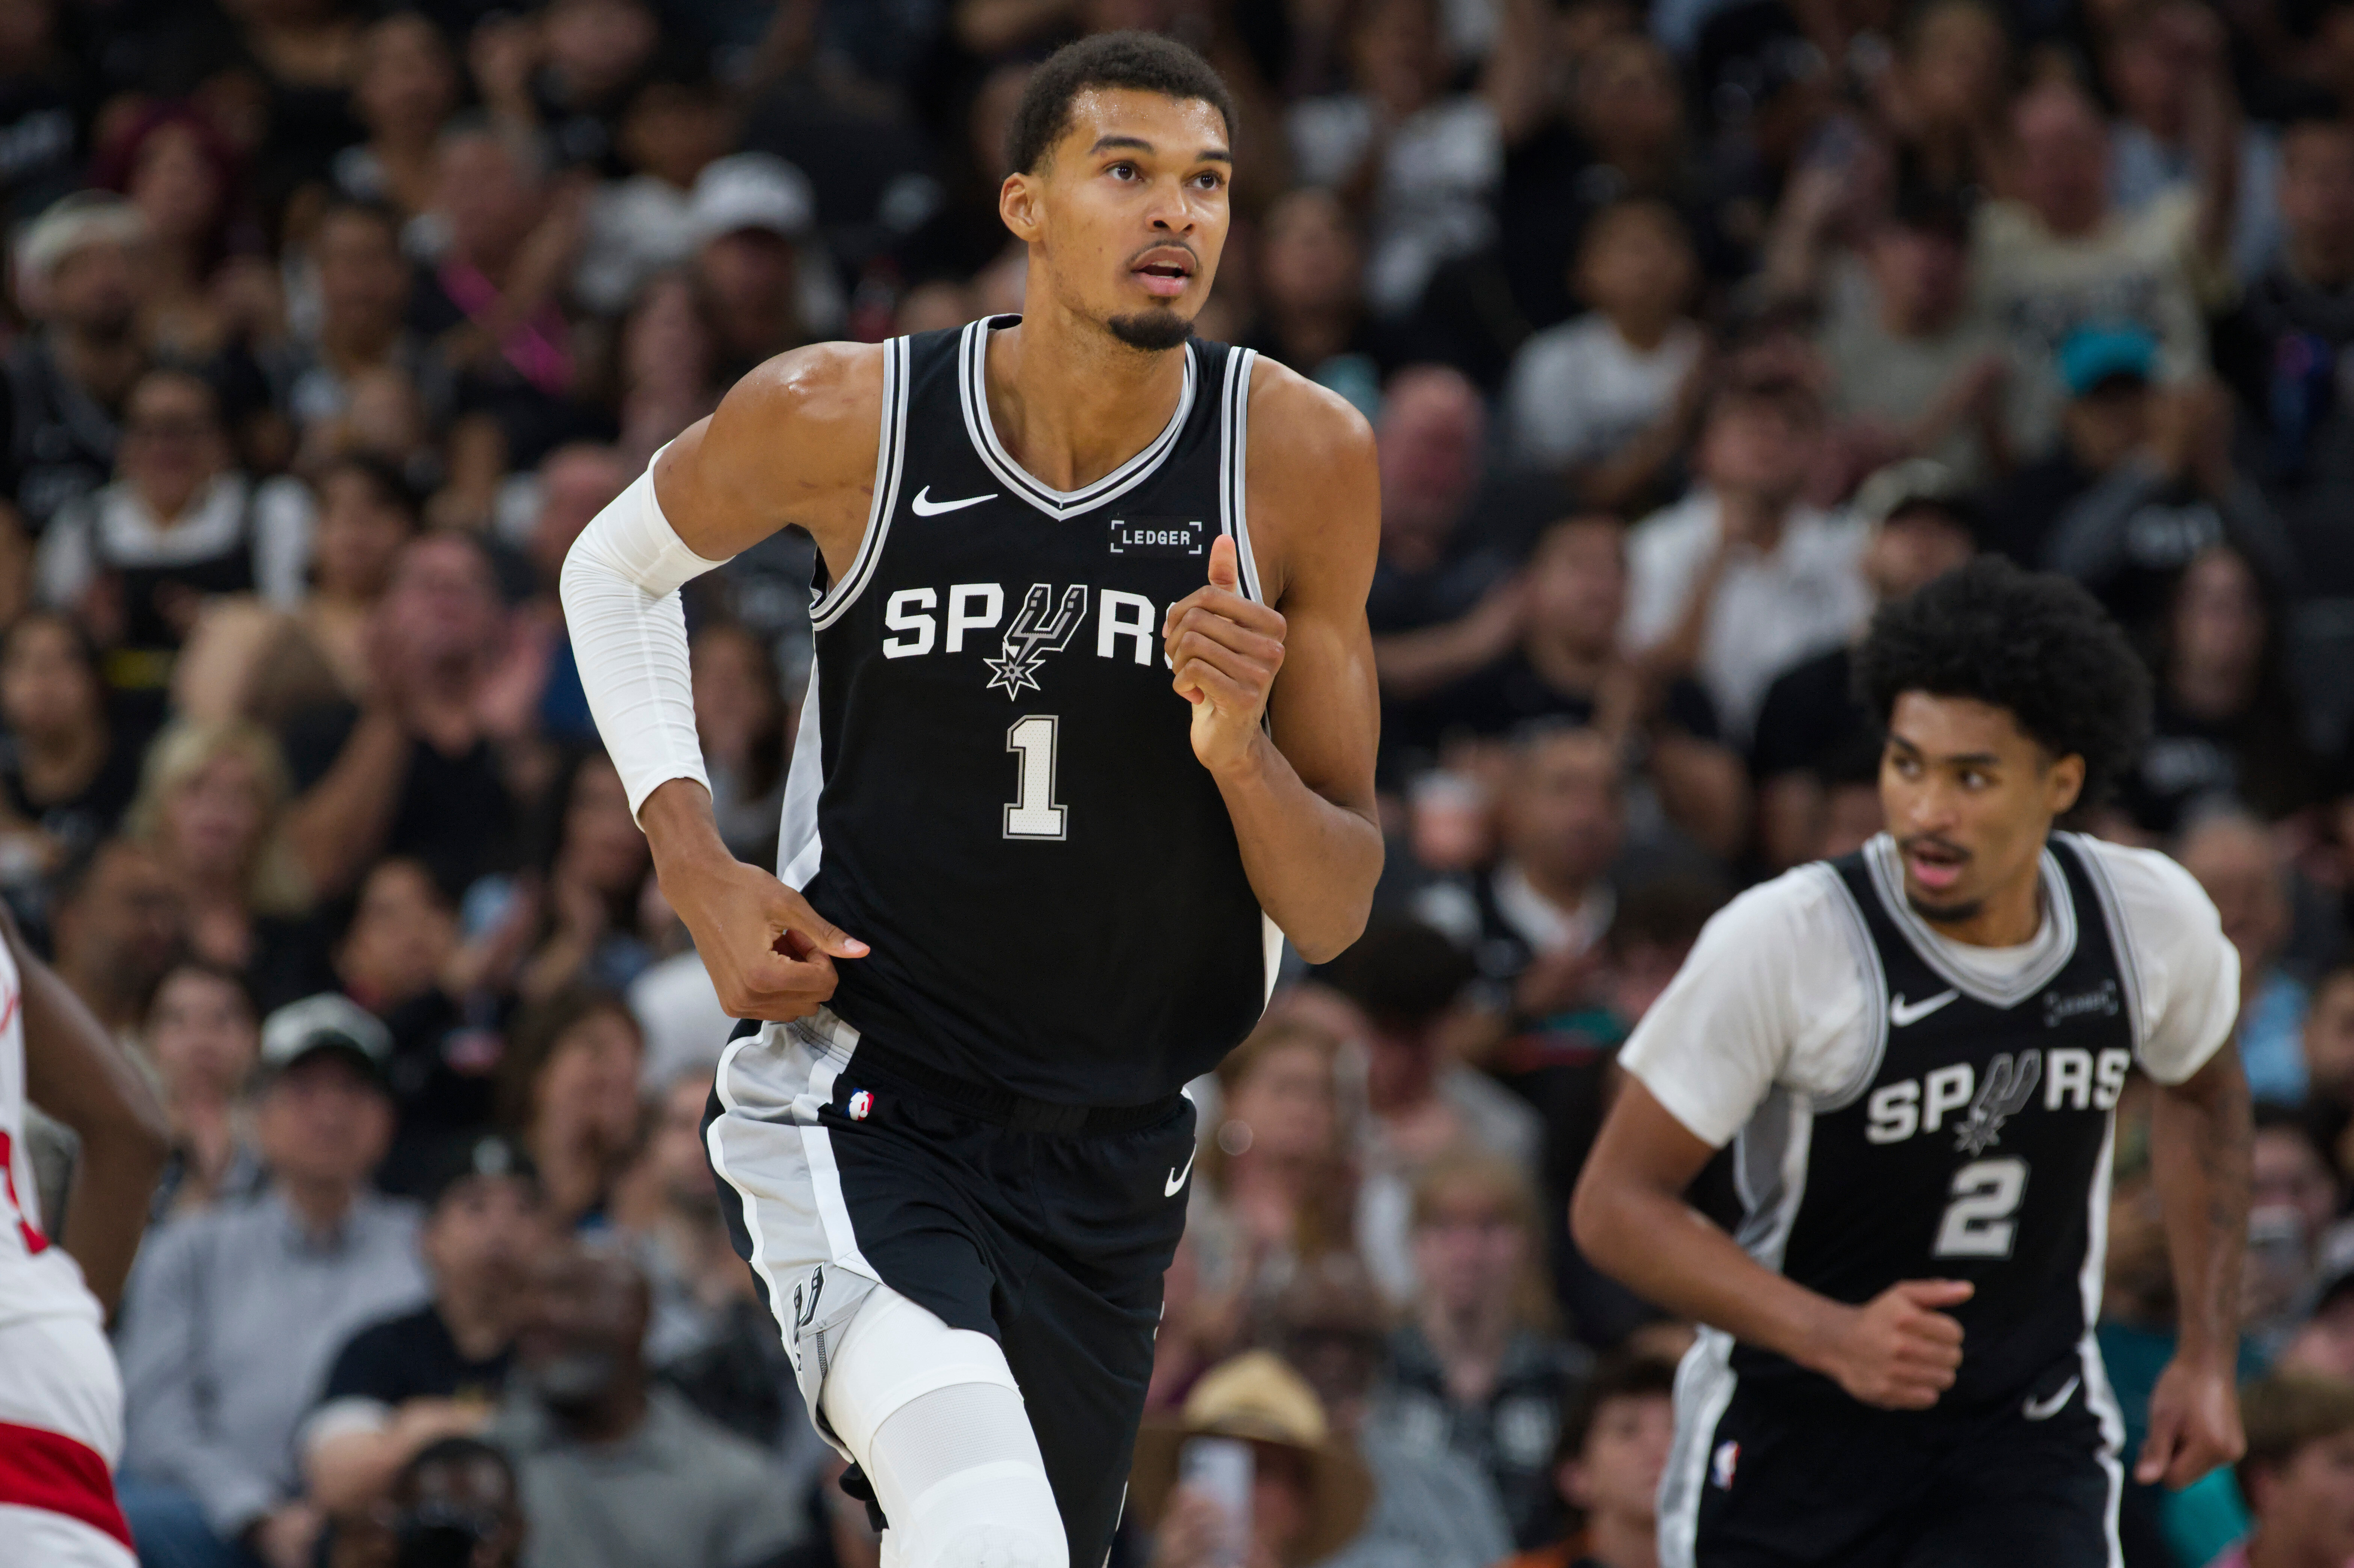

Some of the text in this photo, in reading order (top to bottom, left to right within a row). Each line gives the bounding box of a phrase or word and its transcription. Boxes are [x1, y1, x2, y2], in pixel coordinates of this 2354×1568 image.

[1122, 530, 1190, 545] LEDGER
[883, 583, 1176, 702] SPUR
[1003, 715, 1068, 841] 1
[1865, 1047, 2131, 1156] SPURS
[1931, 1157, 2030, 1259] 2
